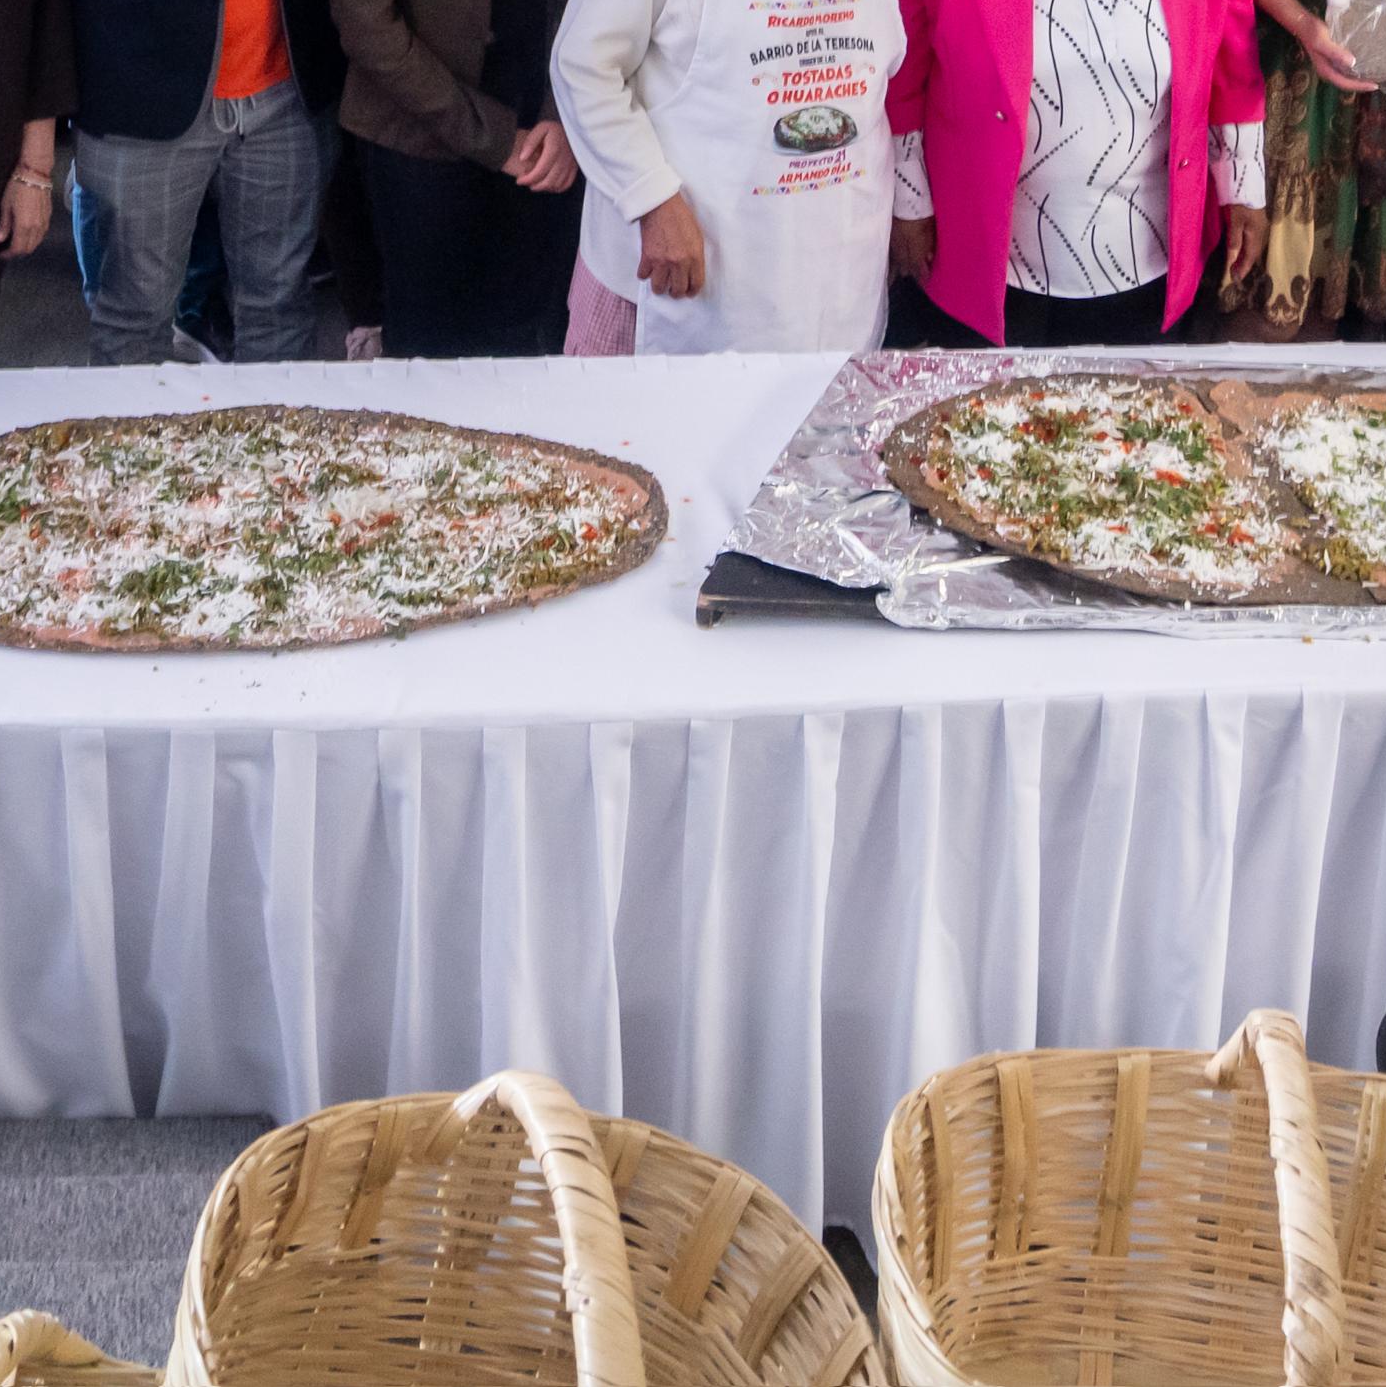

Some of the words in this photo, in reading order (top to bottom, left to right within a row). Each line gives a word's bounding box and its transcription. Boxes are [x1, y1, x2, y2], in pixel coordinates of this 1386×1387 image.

[767, 13, 813, 29] RICARDO
[749, 43, 794, 67] BARRIO
[796, 40, 810, 56] DE
[811, 37, 822, 53] LA
[824, 36, 875, 54] TERESONA
[781, 64, 853, 88] TOSTADAS
[766, 90, 780, 106] O
[781, 79, 868, 104] HUARACHES
[778, 167, 830, 185] ARMANDO
